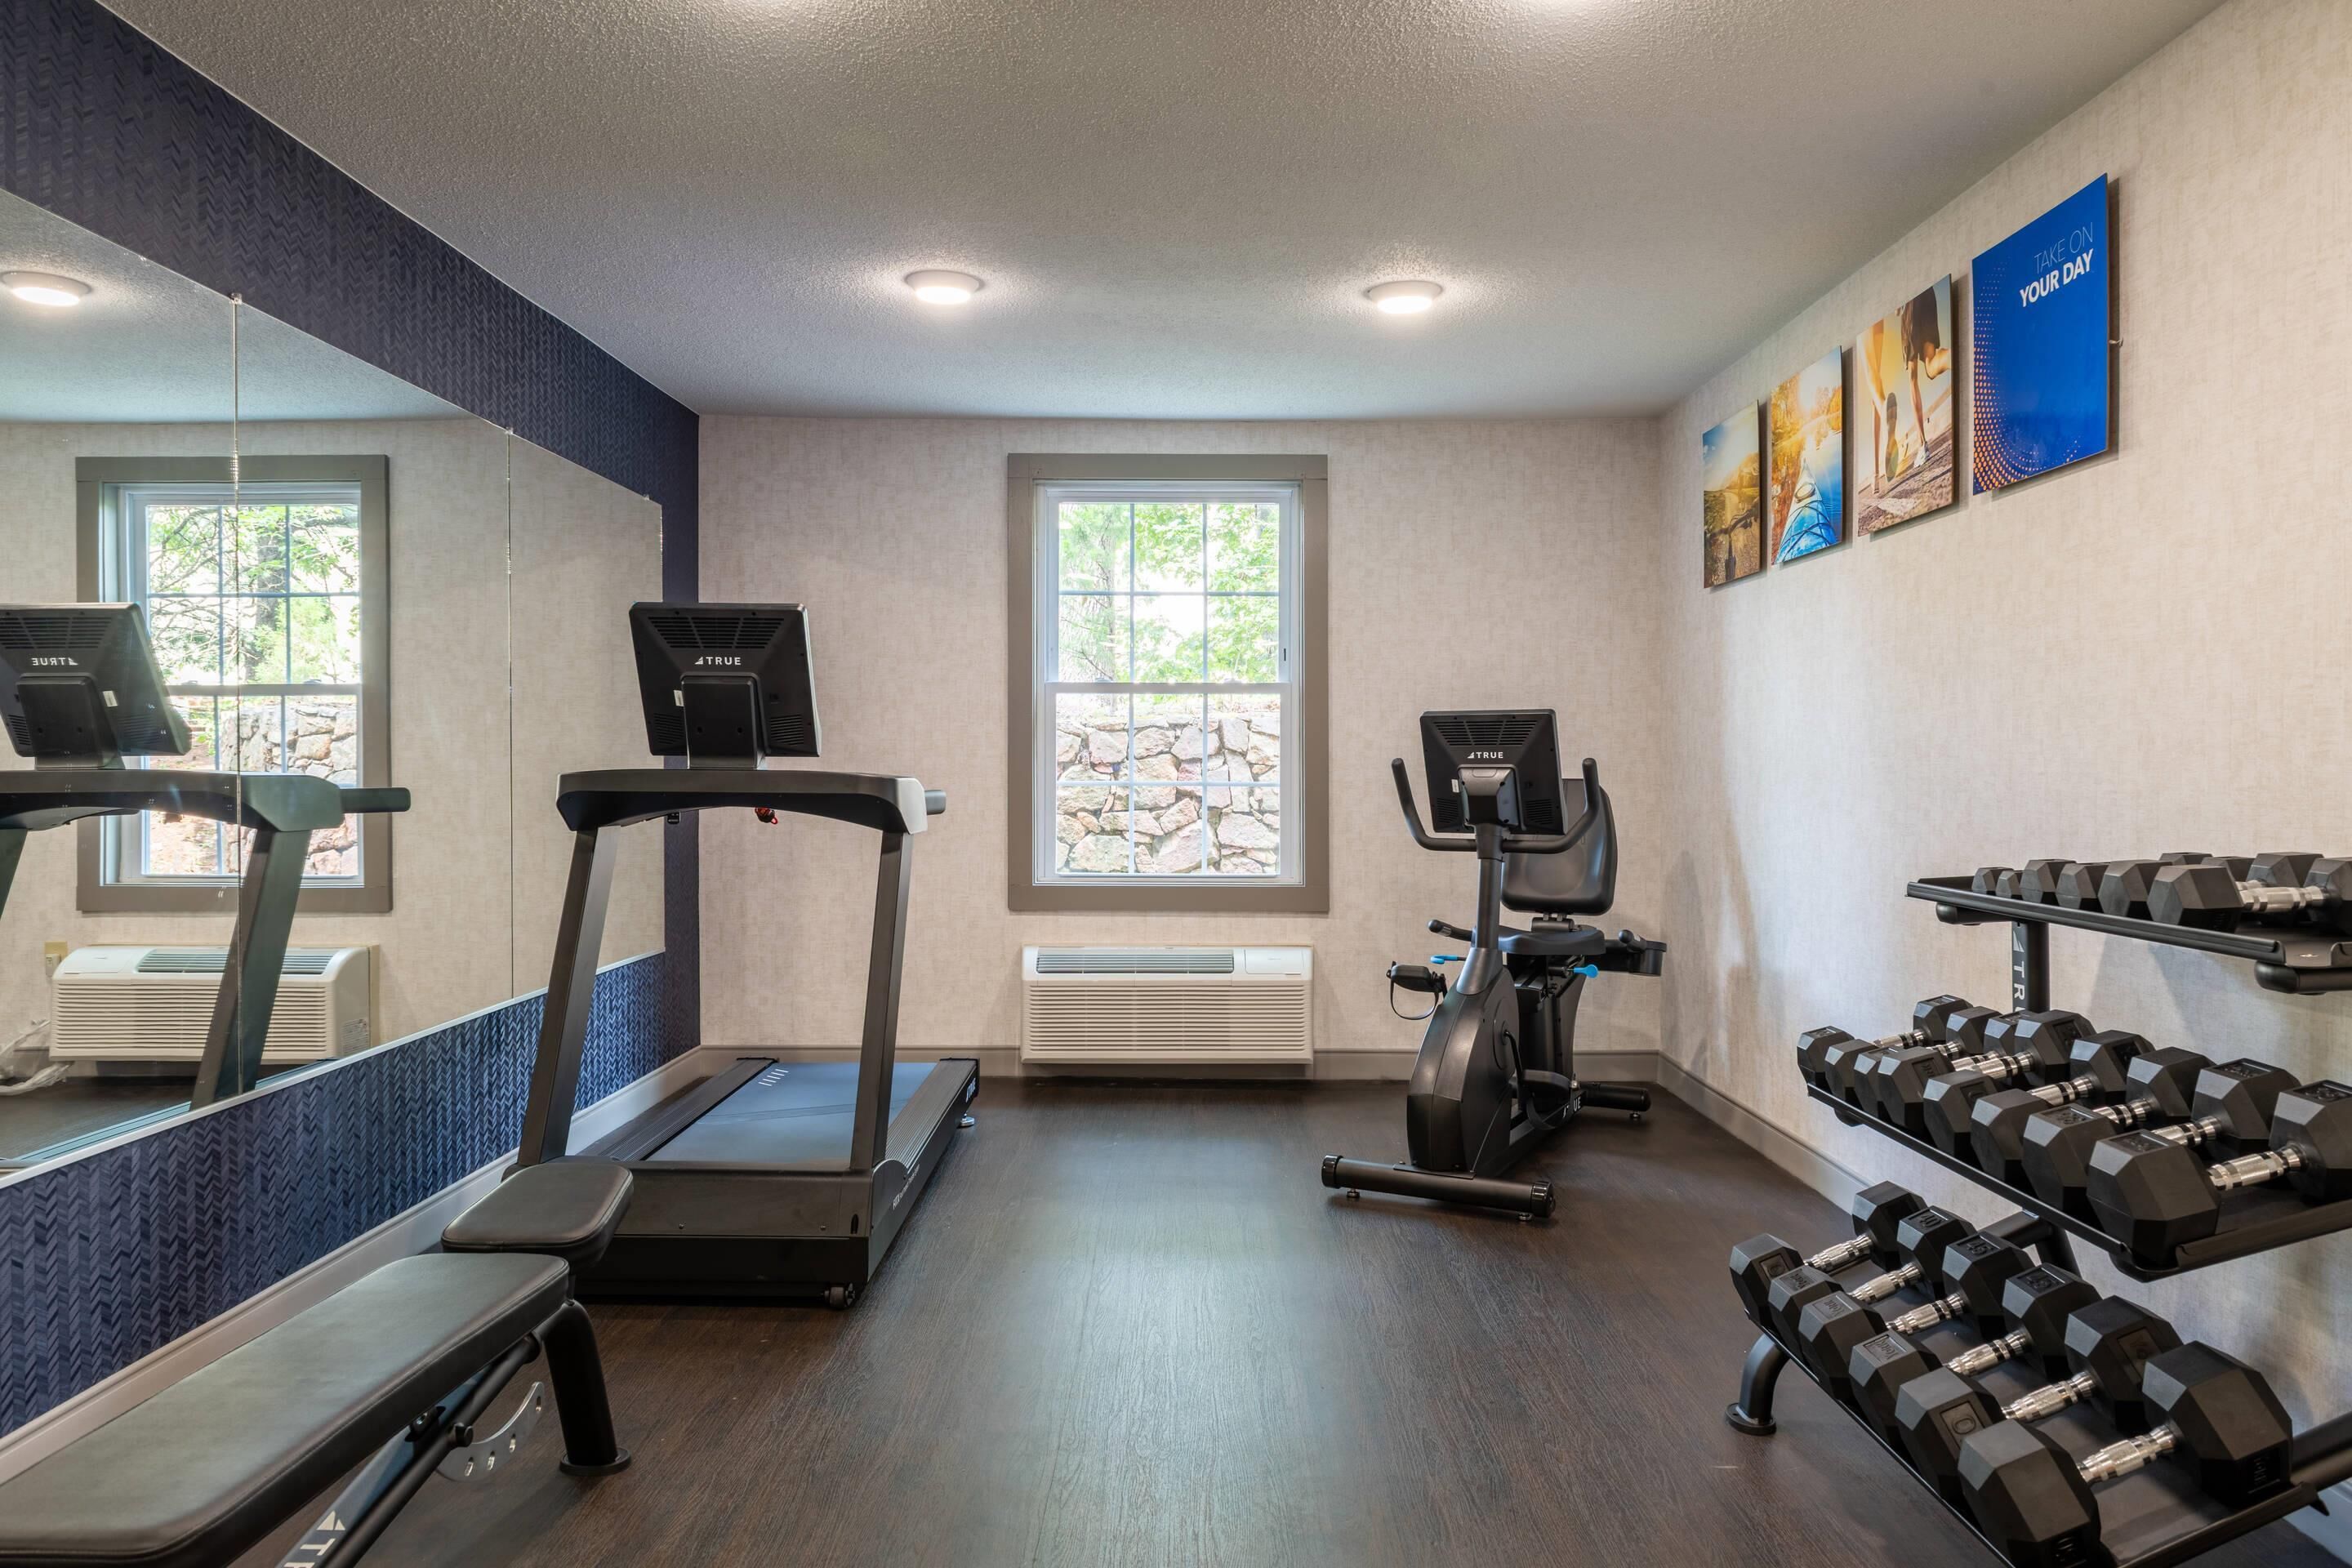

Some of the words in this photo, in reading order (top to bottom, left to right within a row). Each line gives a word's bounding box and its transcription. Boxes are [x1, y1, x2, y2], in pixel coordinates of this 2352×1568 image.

[2034, 238, 2065, 274] TAKE
[2070, 221, 2093, 253] ON
[2020, 270, 2060, 307] YOUR
[2063, 248, 2094, 286] DAY
[706, 657, 742, 666] TRUE
[2013, 960, 2025, 1012] TR
